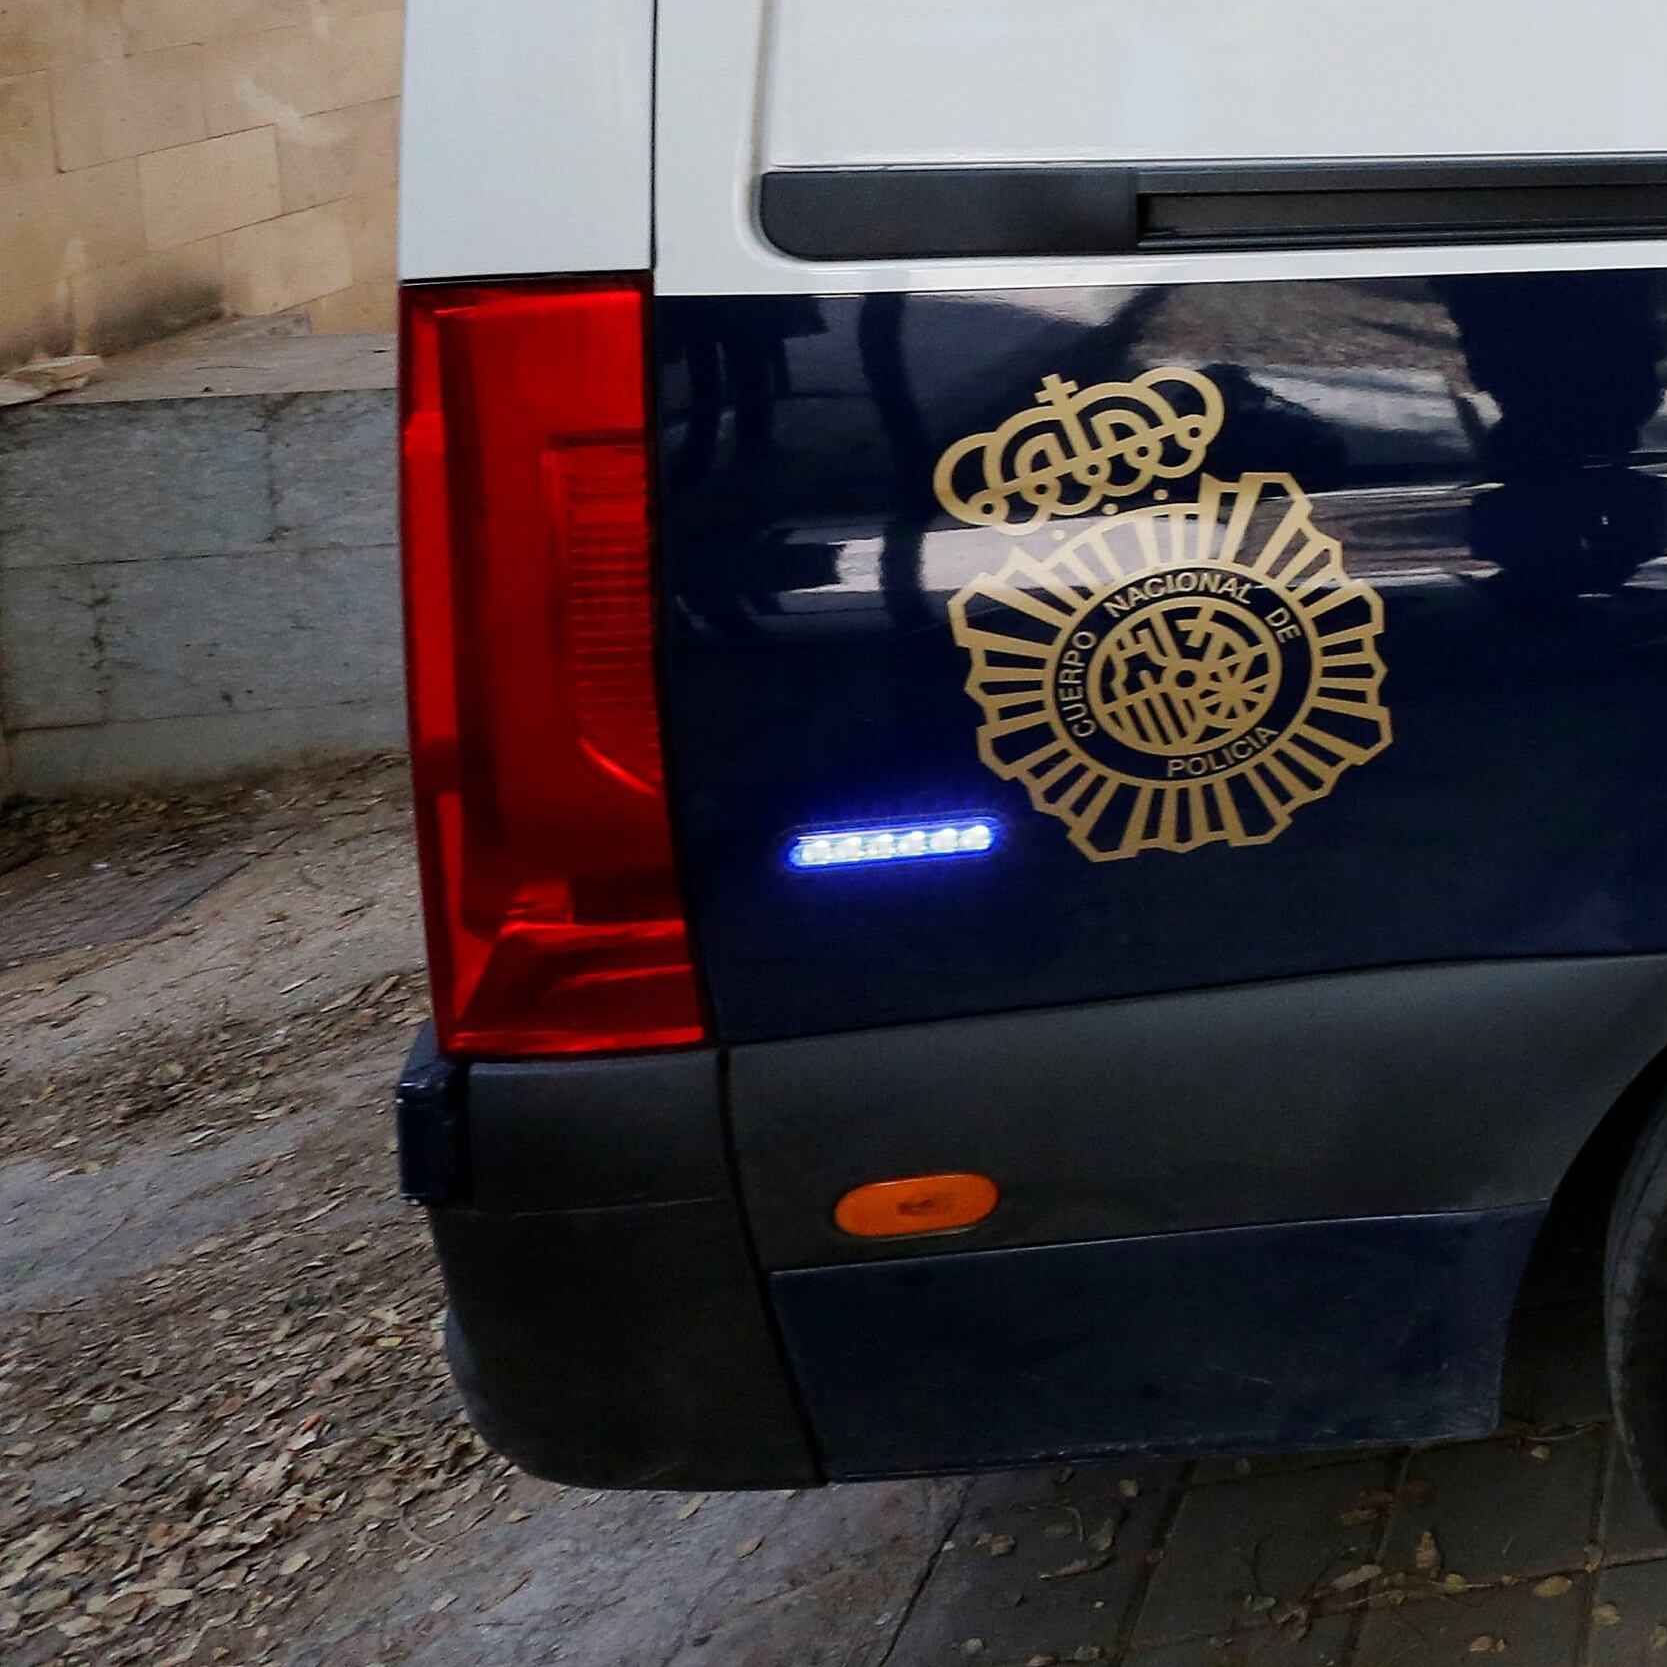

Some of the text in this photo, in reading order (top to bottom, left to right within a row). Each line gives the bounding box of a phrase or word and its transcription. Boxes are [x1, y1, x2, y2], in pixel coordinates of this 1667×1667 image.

[1058, 571, 1302, 778] CUERPO NACIONAL DE POLICIA
